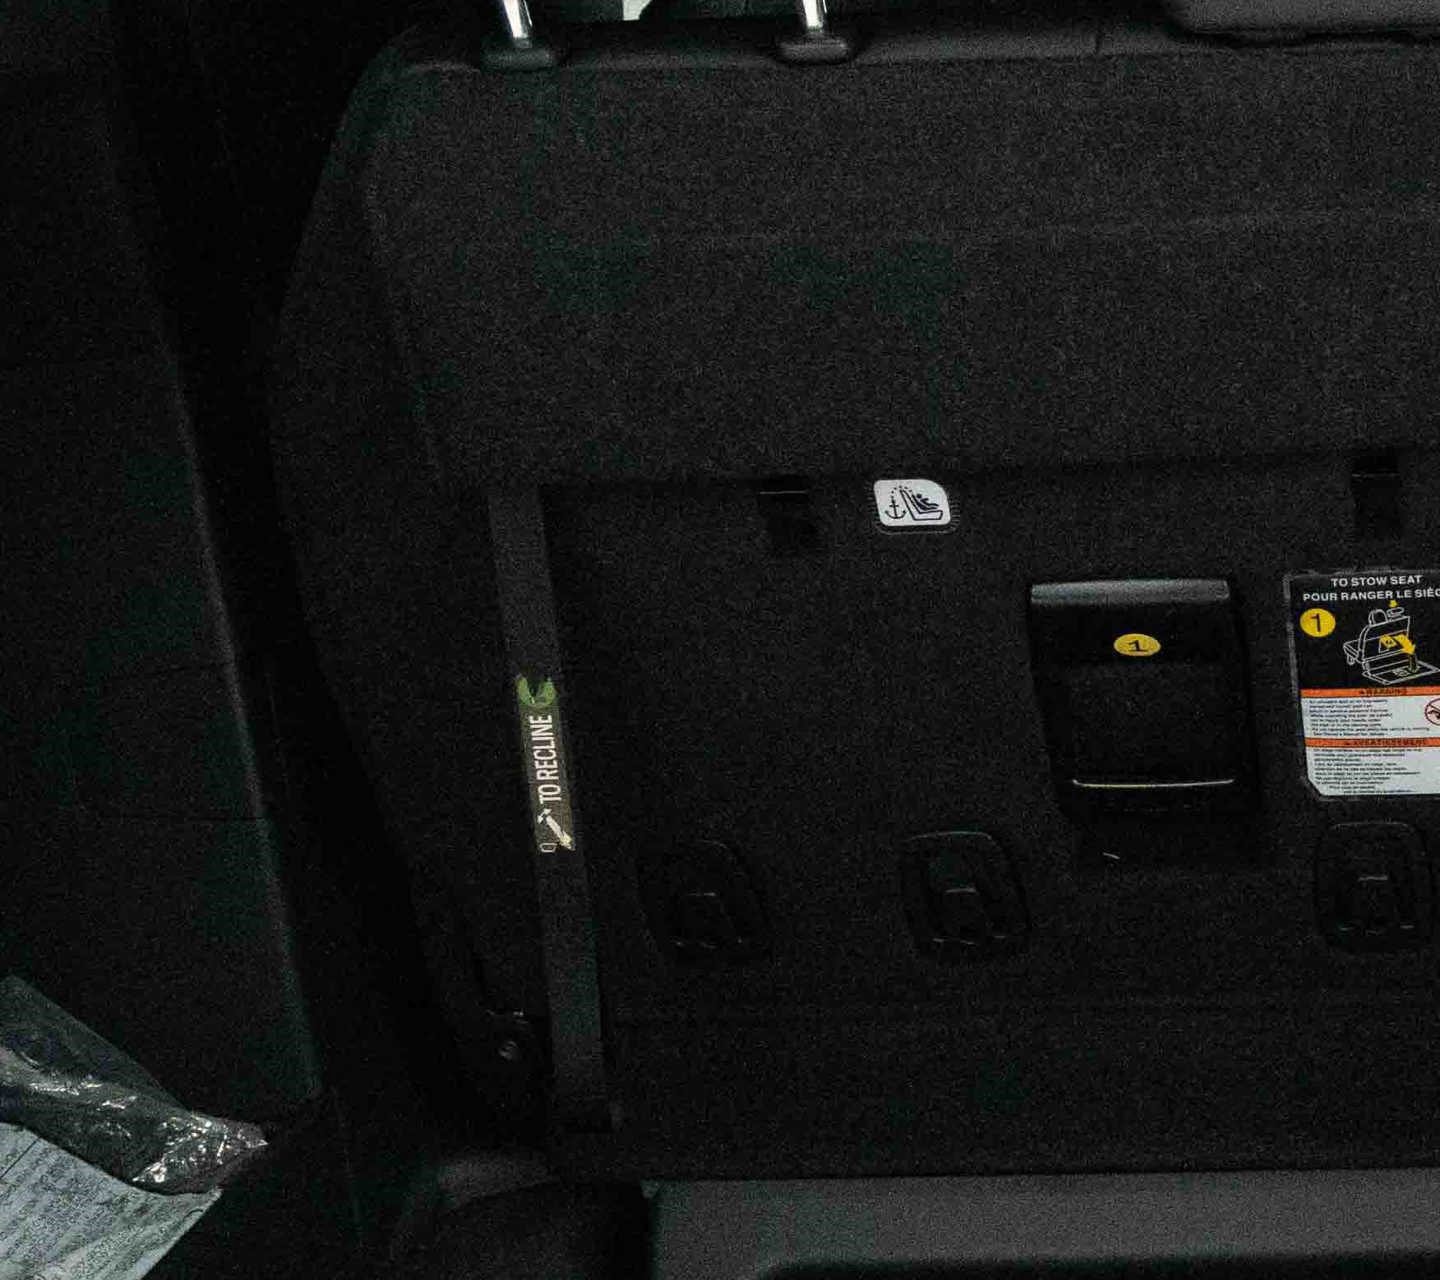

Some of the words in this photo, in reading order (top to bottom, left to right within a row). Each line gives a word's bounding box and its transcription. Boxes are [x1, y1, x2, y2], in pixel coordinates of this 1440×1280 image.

[1331, 577, 1348, 588] TO
[1351, 576, 1387, 587] STOW
[1390, 575, 1423, 586] SEAT
[1303, 592, 1338, 602] POUR
[1341, 590, 1394, 601] RANGER
[1396, 589, 1412, 599] LE
[529, 715, 559, 781] RECLINE
[536, 783, 562, 805] TO
